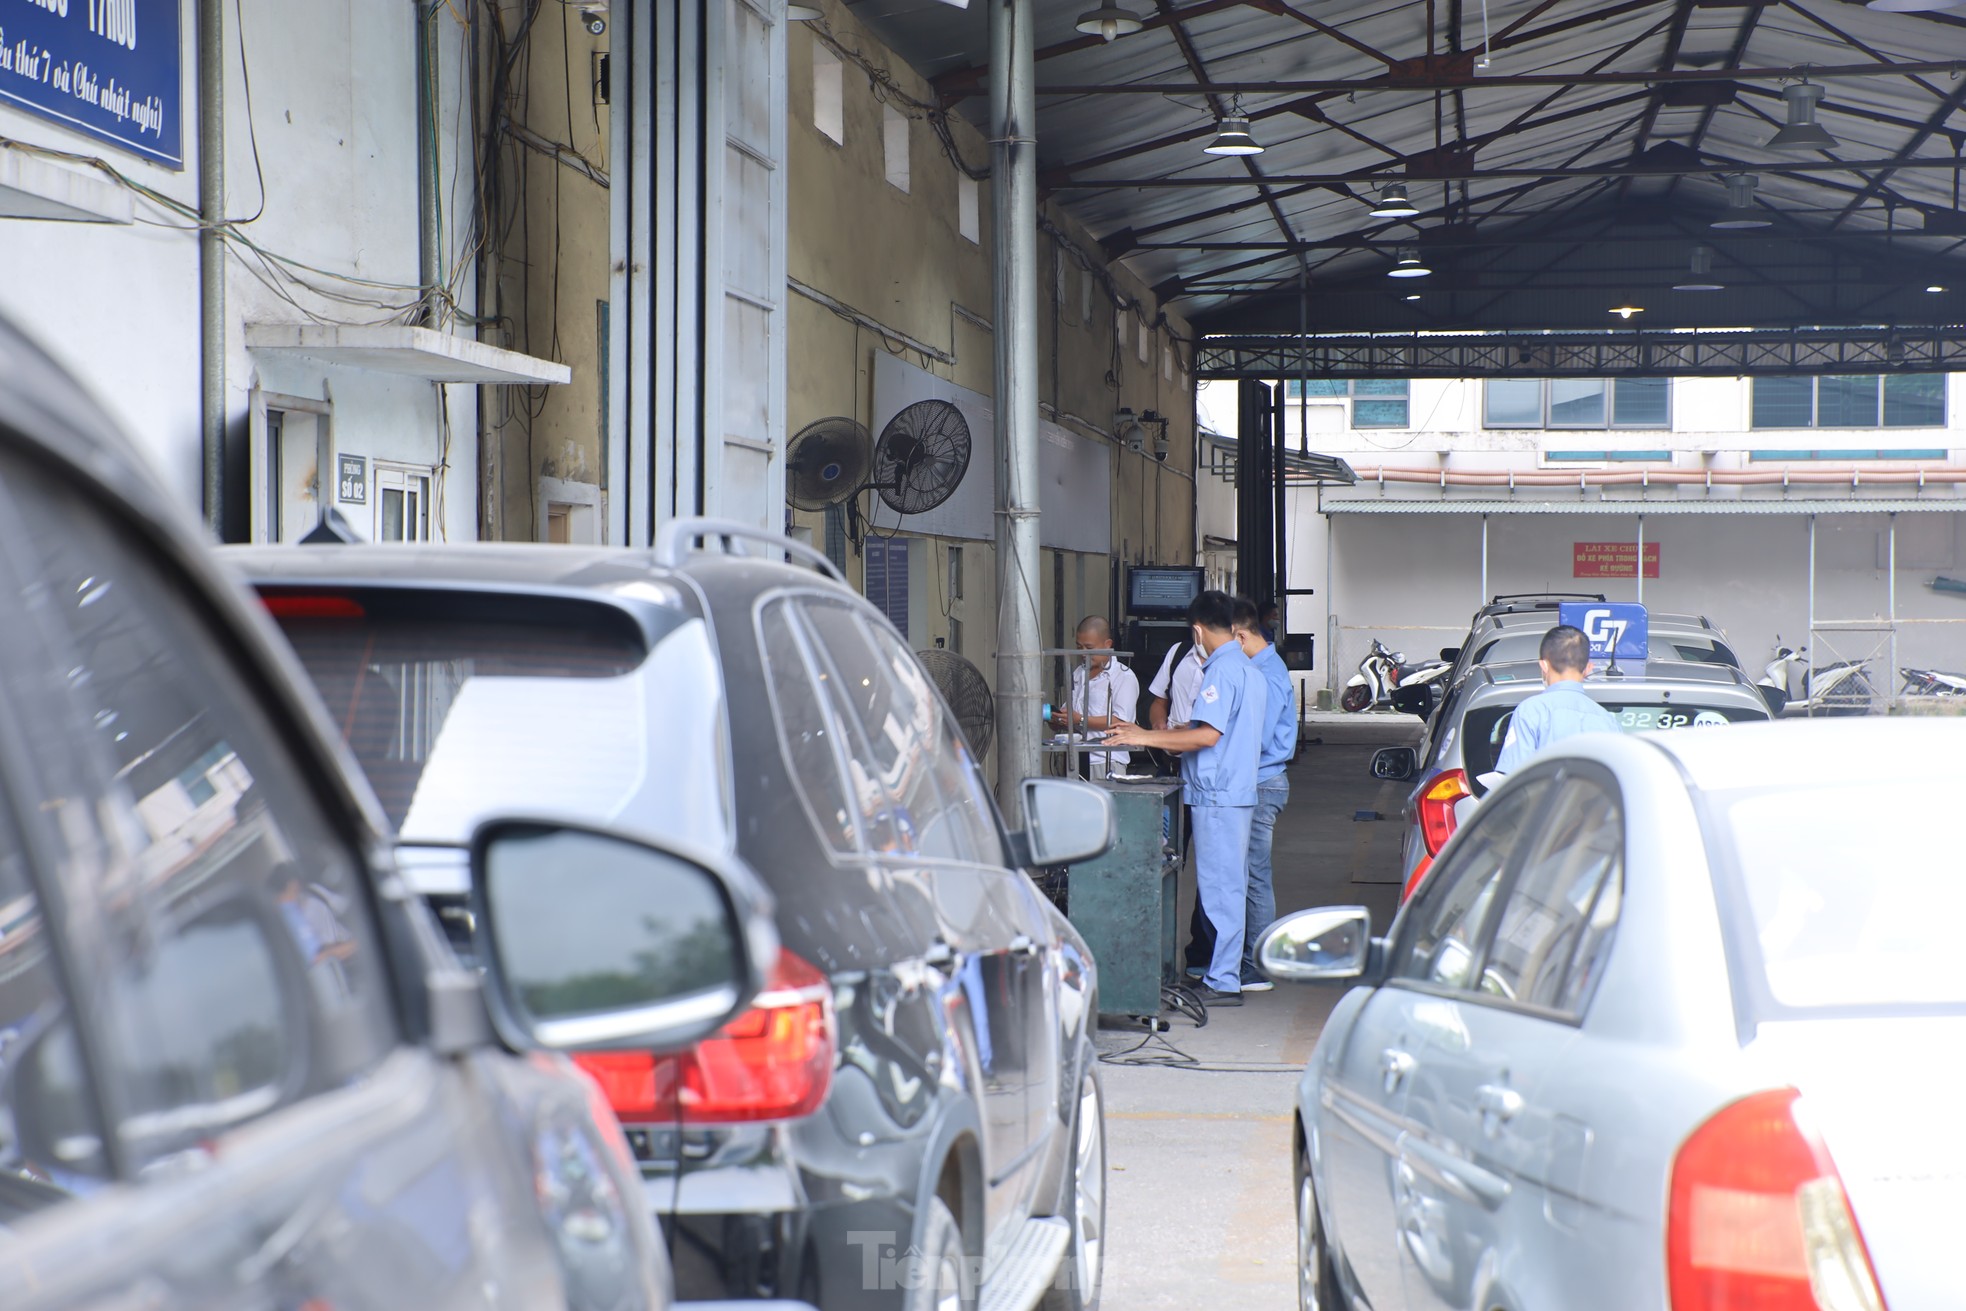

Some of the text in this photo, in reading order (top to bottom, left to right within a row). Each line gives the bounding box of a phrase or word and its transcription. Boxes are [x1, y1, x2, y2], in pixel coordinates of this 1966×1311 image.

[15, 39, 40, 80] thứ
[42, 49, 51, 83] 7
[53, 60, 71, 93] và
[73, 61, 99, 105] Chủ
[101, 78, 130, 122] nhật
[353, 482, 364, 499] 02
[1583, 609, 1628, 652] G7
[1621, 712, 1652, 728] 32
[1656, 713, 1688, 729] 32
